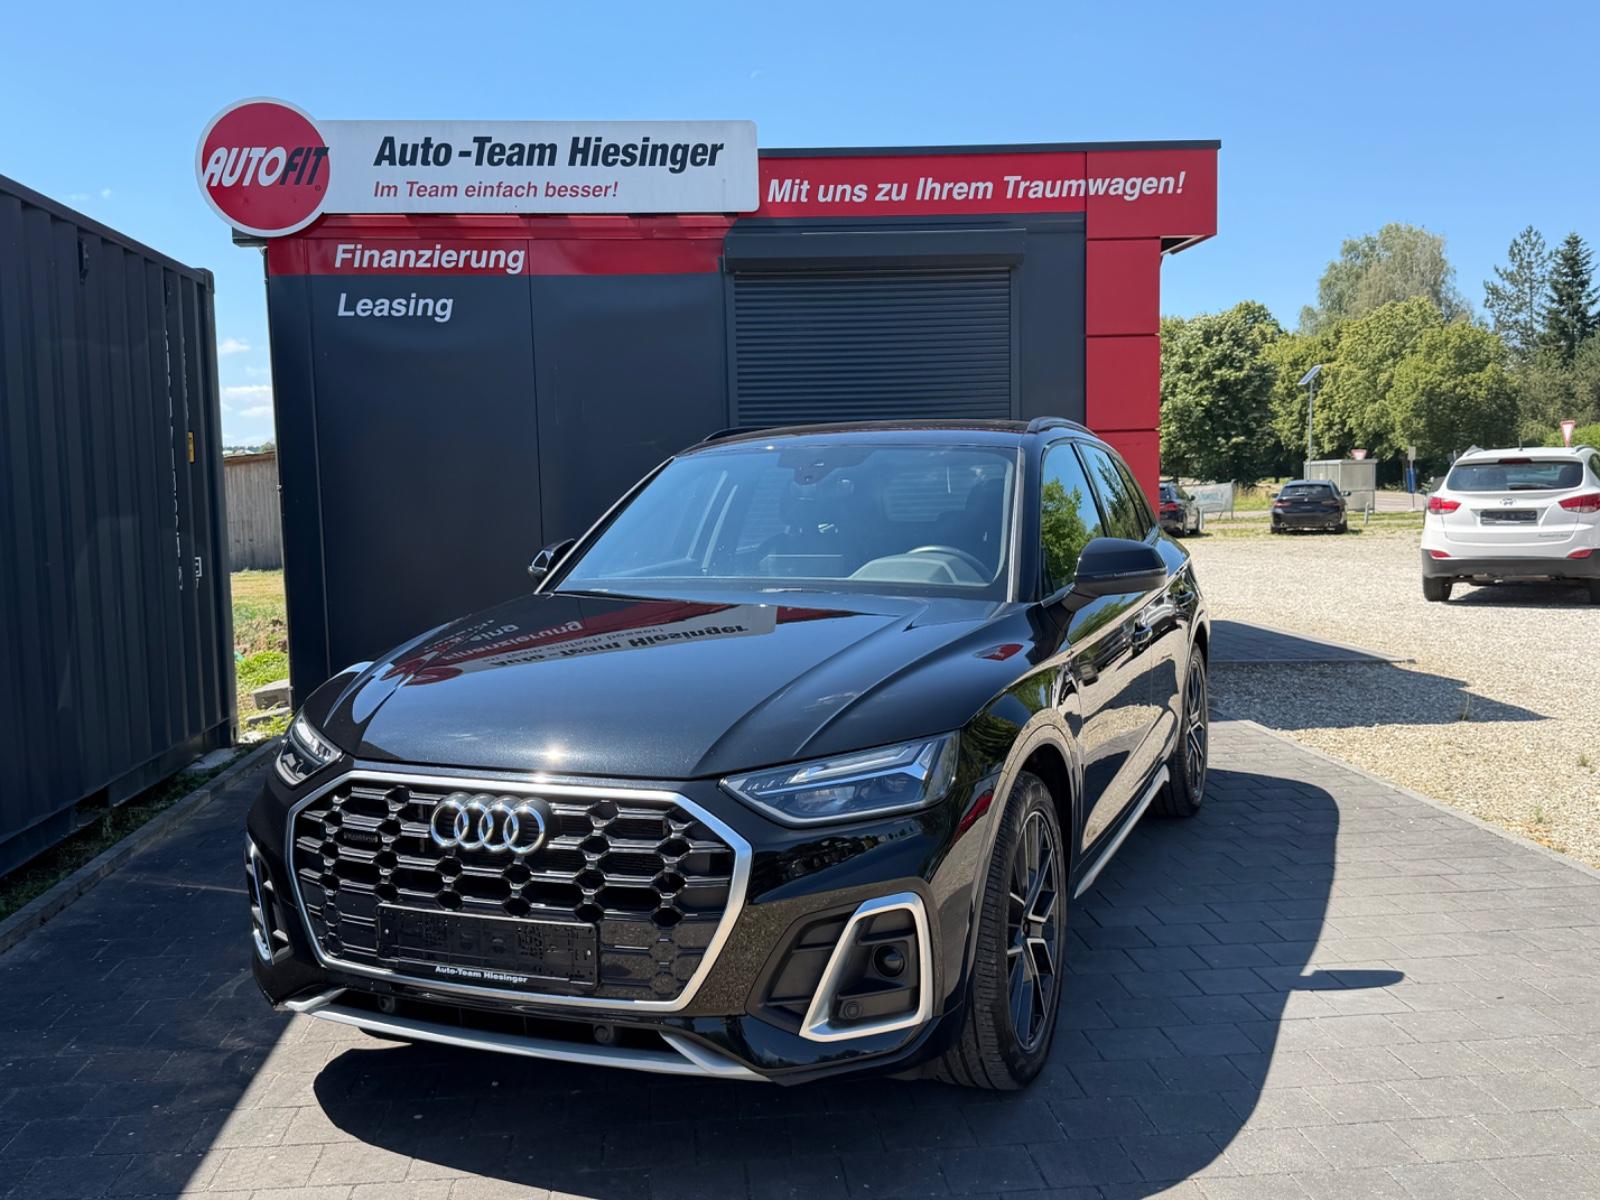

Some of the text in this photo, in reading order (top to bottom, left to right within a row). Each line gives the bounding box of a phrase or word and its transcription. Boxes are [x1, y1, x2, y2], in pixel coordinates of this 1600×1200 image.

[203, 146, 330, 187] AUTOFIT
[567, 136, 725, 174] Hiesinger
[373, 180, 619, 198] Im Team einfach besser!
[767, 171, 1186, 203] Mit uns zu Ihrem Traumwagen!
[334, 243, 526, 275] Finanzierung
[337, 292, 454, 323] Leasing
